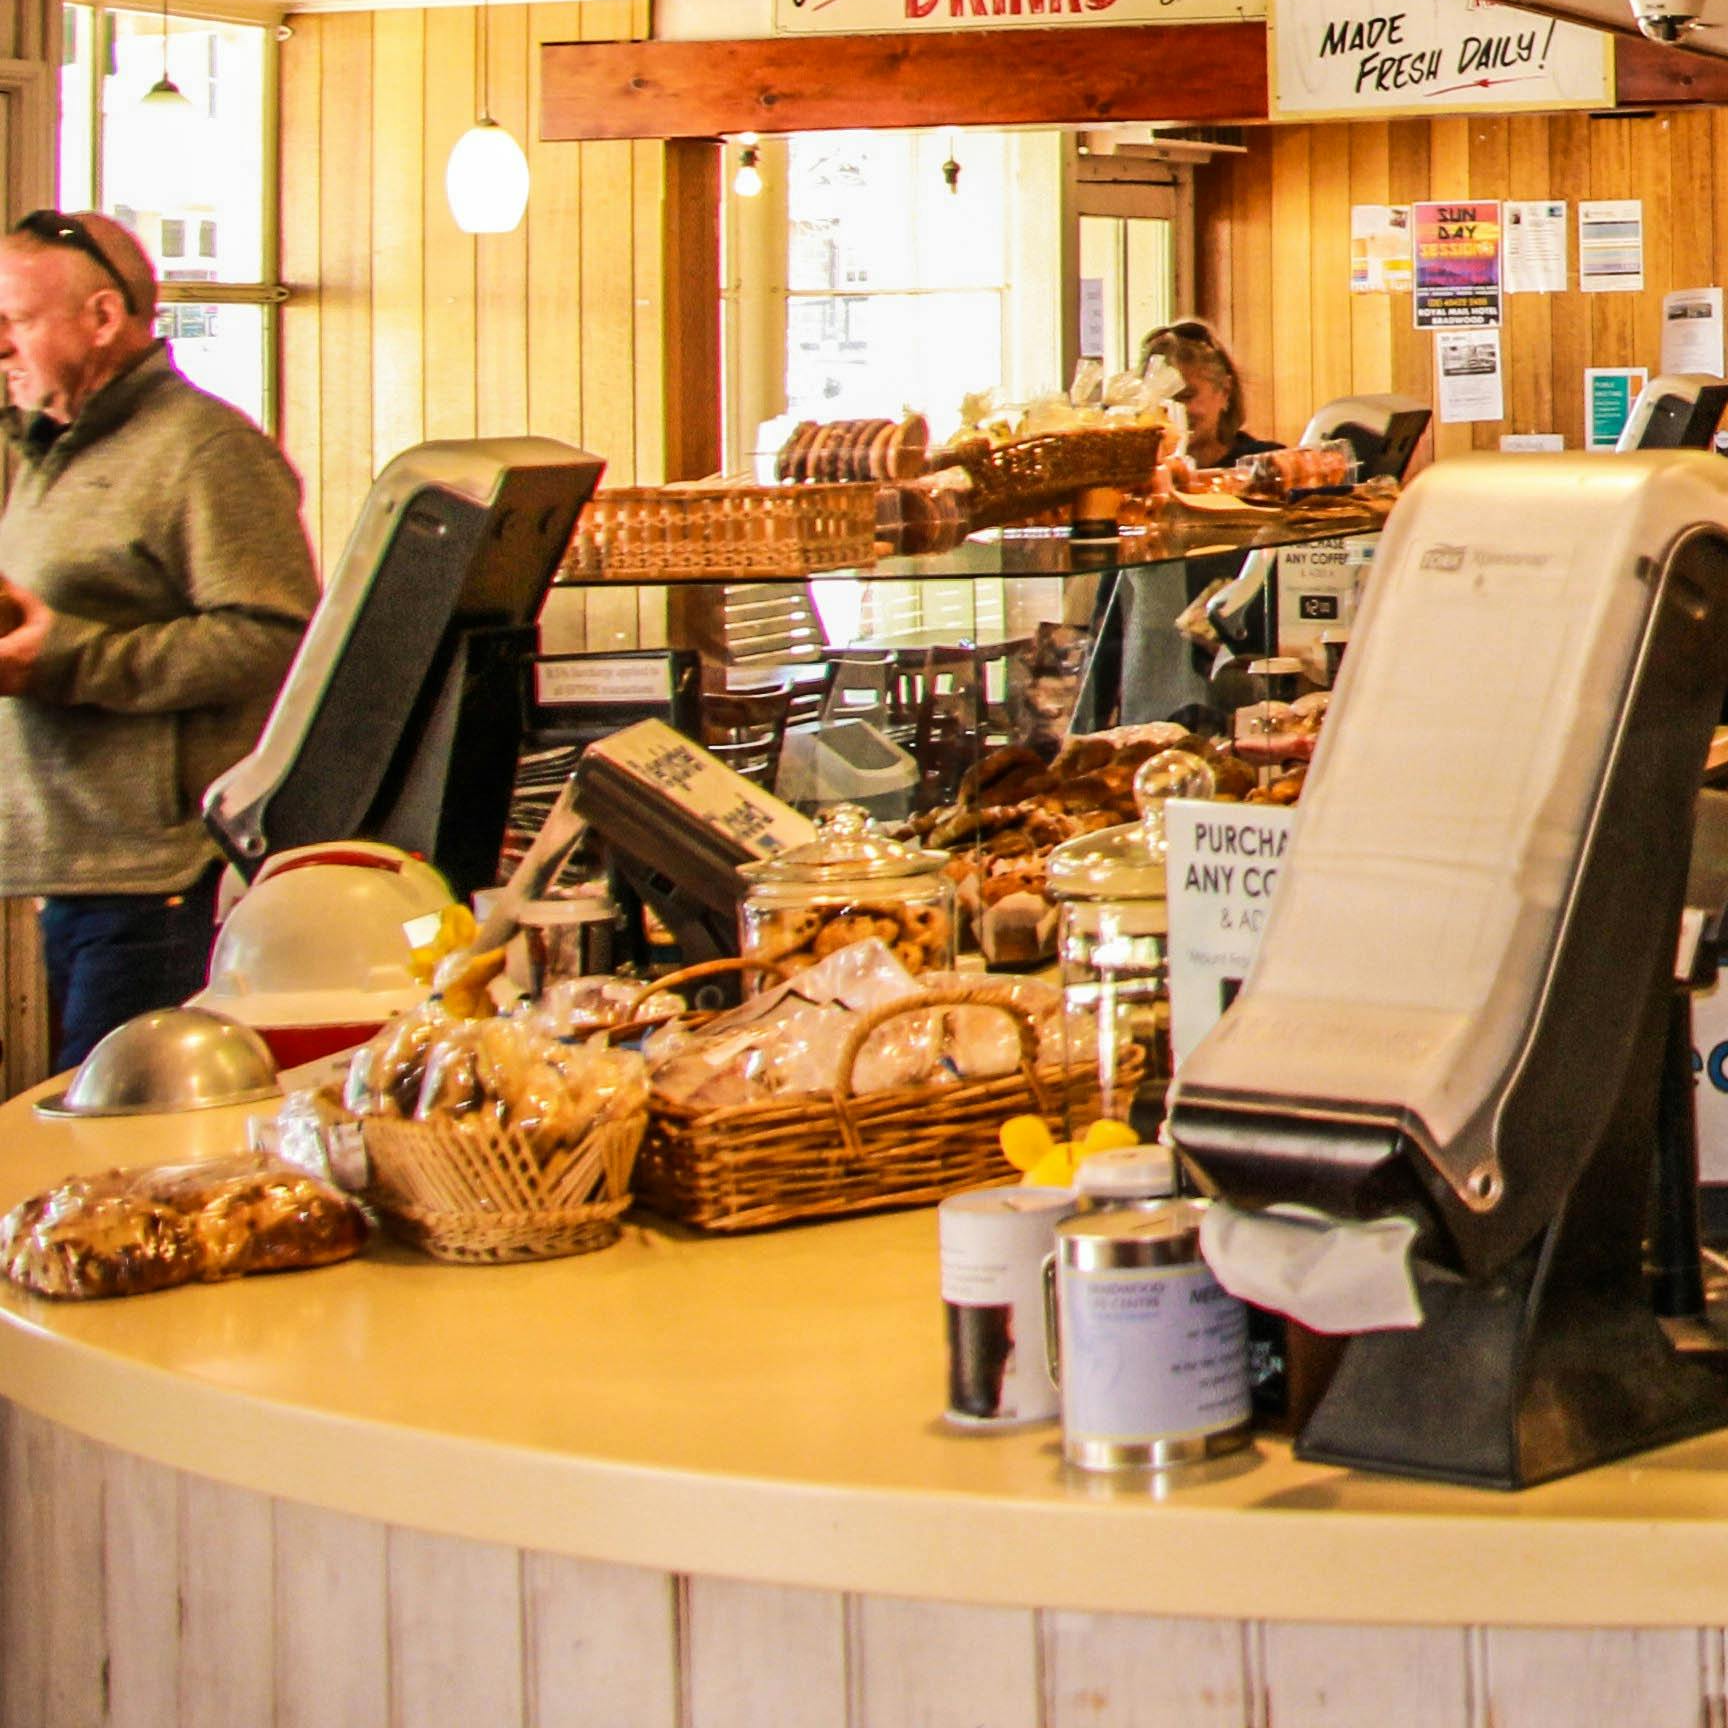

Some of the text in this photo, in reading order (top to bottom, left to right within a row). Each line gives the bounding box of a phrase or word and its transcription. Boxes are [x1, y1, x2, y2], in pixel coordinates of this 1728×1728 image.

[1319, 13, 1407, 58] MADE
[1356, 18, 1558, 94] FRESH DAILY!
[1437, 207, 1477, 223] SUN
[1438, 225, 1477, 240] DAY
[1285, 553, 1306, 565] ANY
[1185, 864, 1235, 895] ANY
[1219, 907, 1233, 929] &
